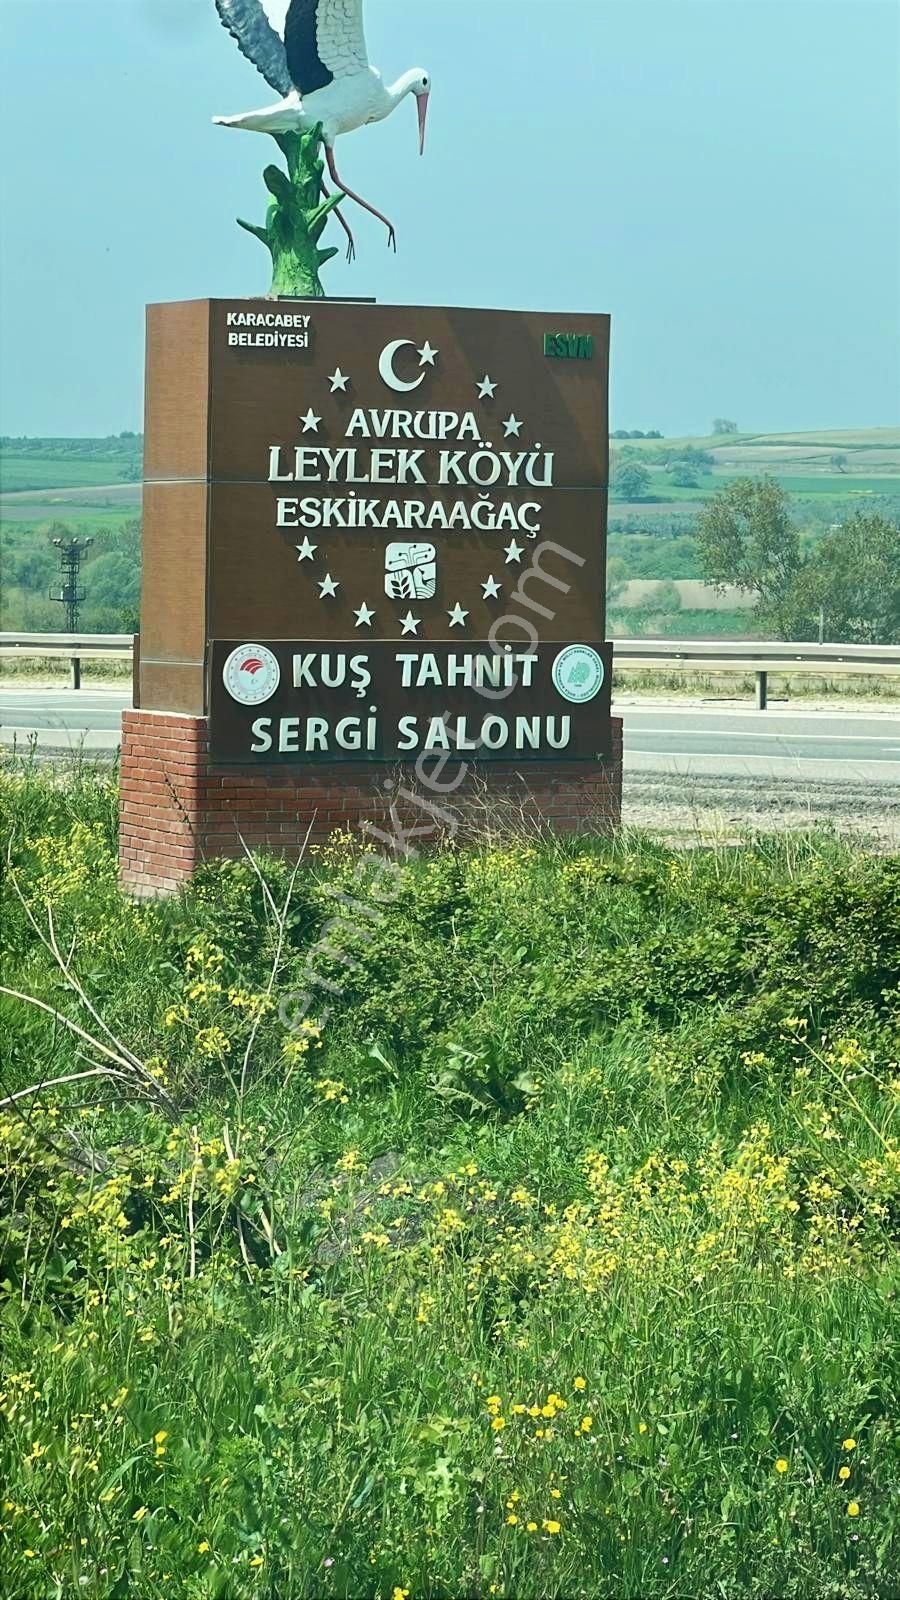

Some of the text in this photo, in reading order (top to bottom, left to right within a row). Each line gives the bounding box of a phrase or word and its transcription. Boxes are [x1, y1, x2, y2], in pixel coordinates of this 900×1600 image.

[226, 312, 311, 328] KARACABEY
[228, 330, 309, 348] BELEDİYESİ
[345, 408, 481, 441] AVRUPA
[267, 445, 427, 484] LEYLEK
[275, 490, 542, 539] ESKİKARAAĞAÇ
[292, 653, 371, 698] KUŞ
[395, 644, 539, 688] TAHNİT
[250, 705, 571, 753] SERGİ SALONU
